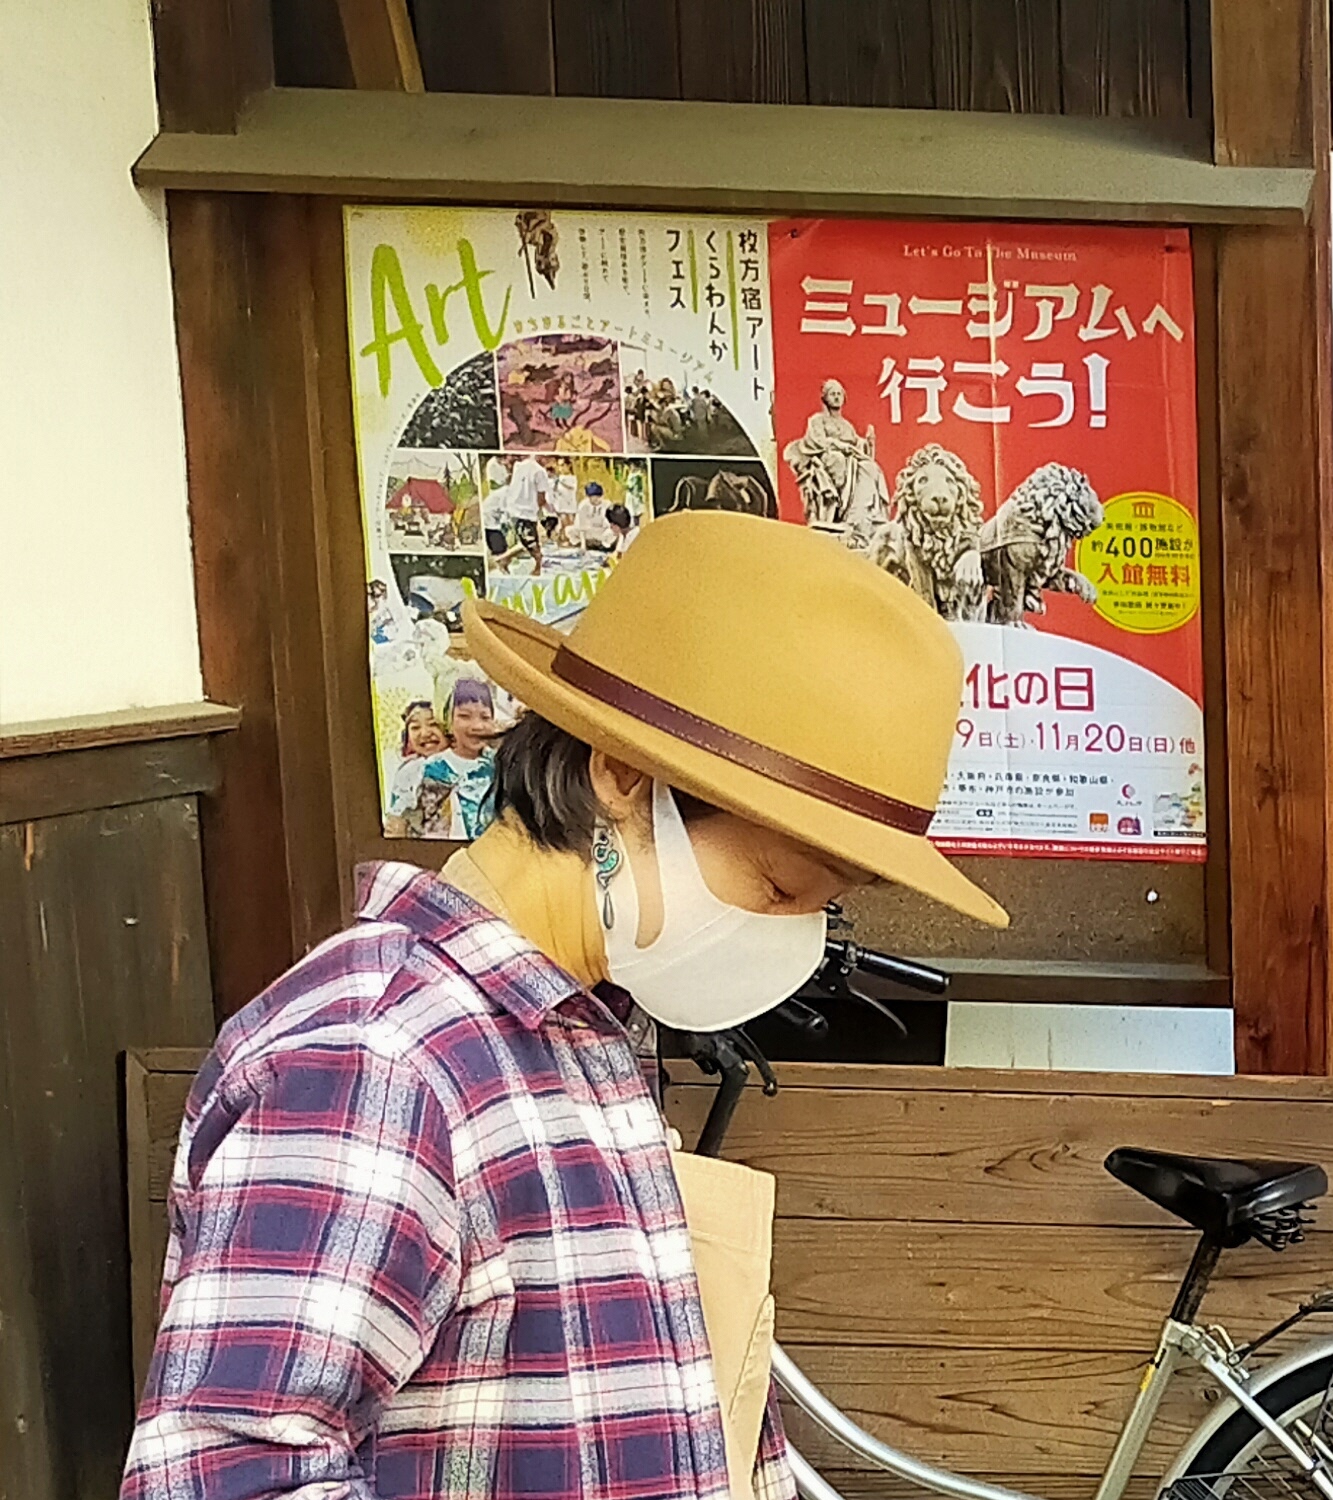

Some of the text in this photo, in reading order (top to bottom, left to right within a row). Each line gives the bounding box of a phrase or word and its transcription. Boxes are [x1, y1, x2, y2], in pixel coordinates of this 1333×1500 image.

[666, 230, 686, 309] フェス
[904, 244, 938, 257] Let's
[942, 245, 961, 258] Go
[1017, 247, 1076, 261] Museum
[360, 237, 512, 398] Art
[705, 230, 728, 361] くらわんか
[738, 229, 765, 401] 枚方宿アート
[800, 275, 1183, 342] ミュージアムへ
[878, 353, 1110, 429] 行こう!
[1097, 562, 1190, 587] 入館無料
[961, 663, 1094, 712] 化の日
